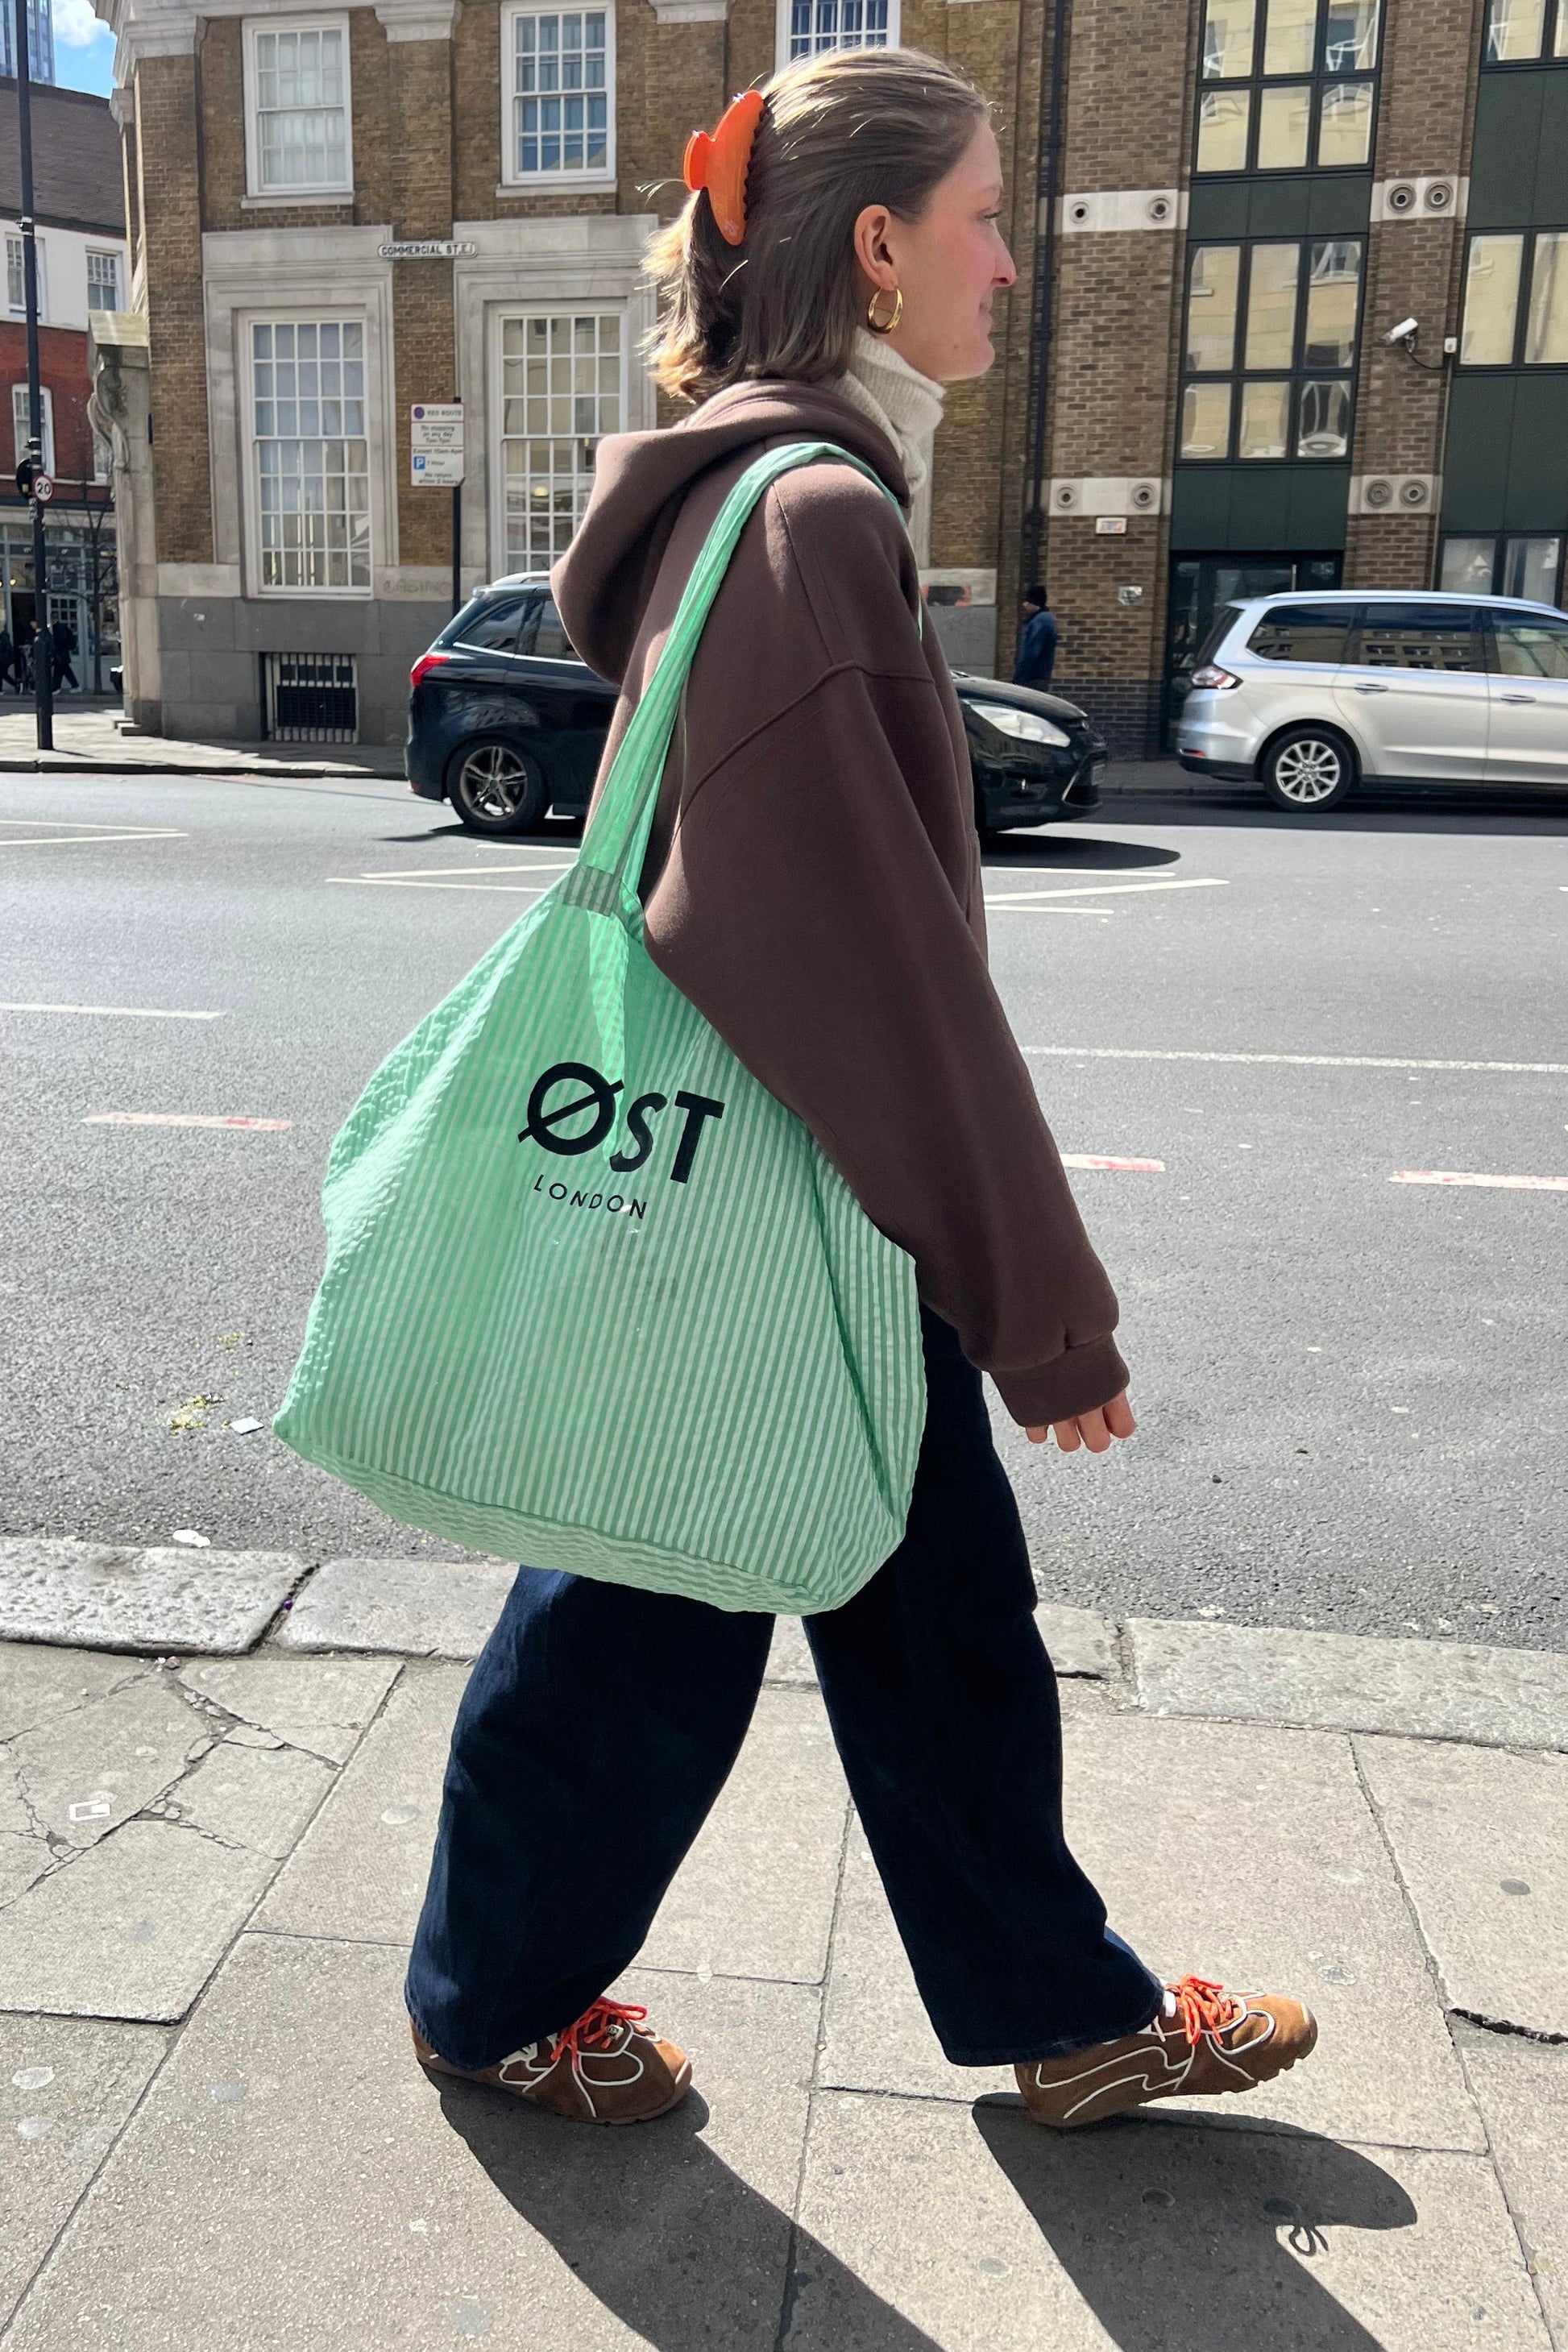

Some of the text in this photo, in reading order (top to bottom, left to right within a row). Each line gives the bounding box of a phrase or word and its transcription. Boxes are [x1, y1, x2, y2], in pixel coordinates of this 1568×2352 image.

[382, 245, 442, 255] COMMERCIAL
[37, 483, 51, 495] 20
[518, 1062, 725, 1184] ØST
[533, 1174, 647, 1219] LONDON
